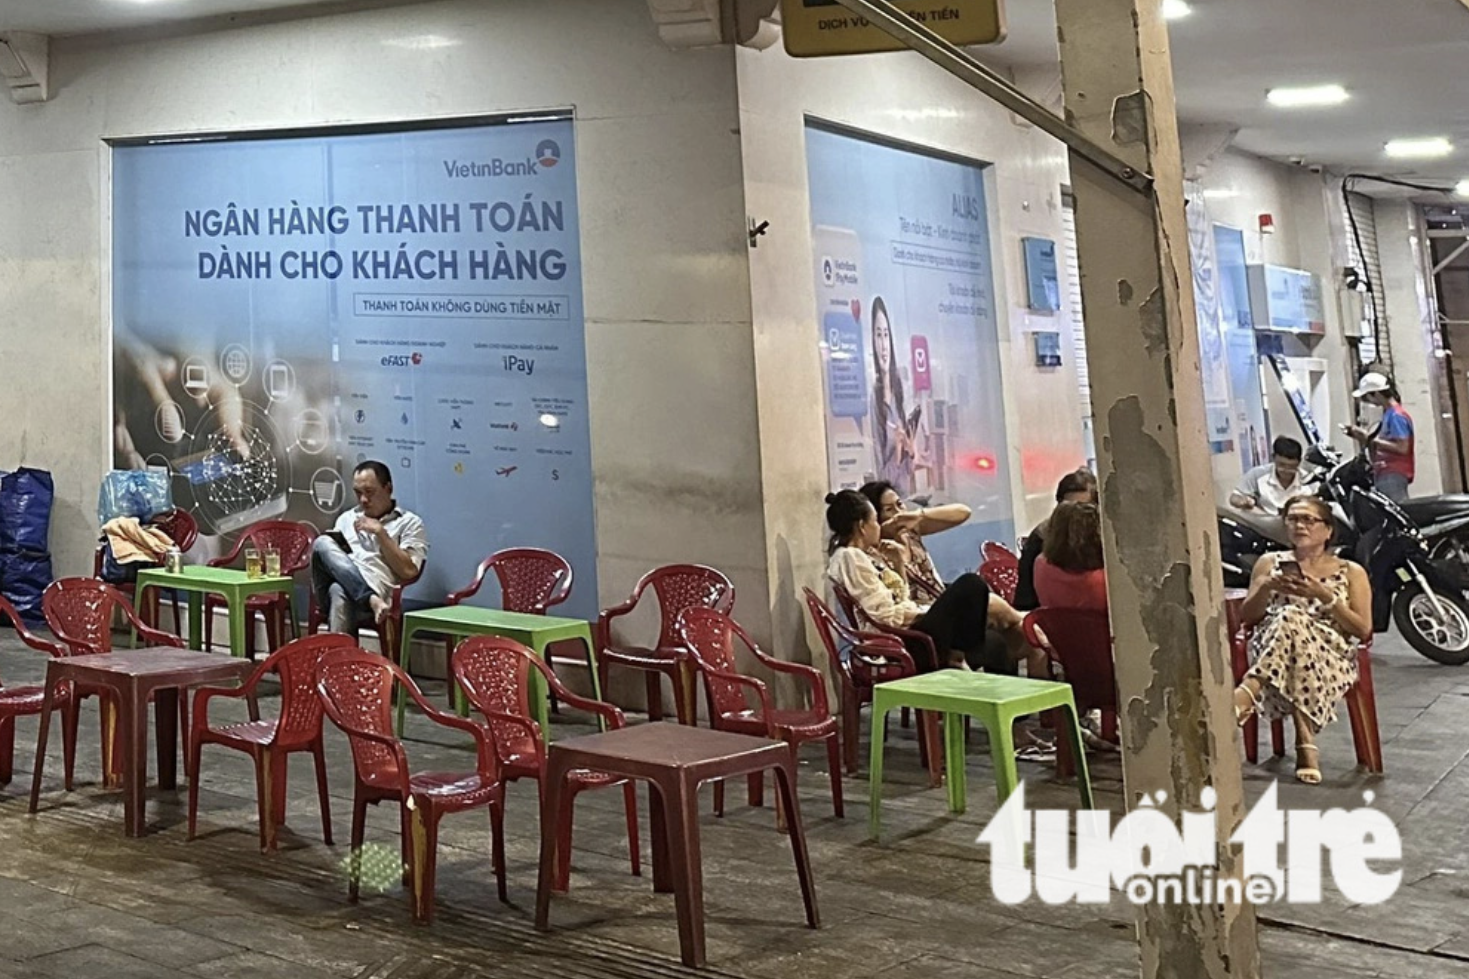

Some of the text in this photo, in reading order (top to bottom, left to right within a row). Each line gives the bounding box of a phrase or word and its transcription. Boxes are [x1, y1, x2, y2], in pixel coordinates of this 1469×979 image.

[443, 156, 539, 180] VietinBank
[183, 192, 565, 239] NGÂN HÀNG THANH TOÁN
[198, 240, 568, 281] DÀNH CHO KHÁCH HÀNG
[362, 295, 562, 317] THANH TOÁN KHÔNG DÙNG TIỀN MẶT
[380, 355, 410, 367] eFAST
[503, 354, 535, 376] iPay
